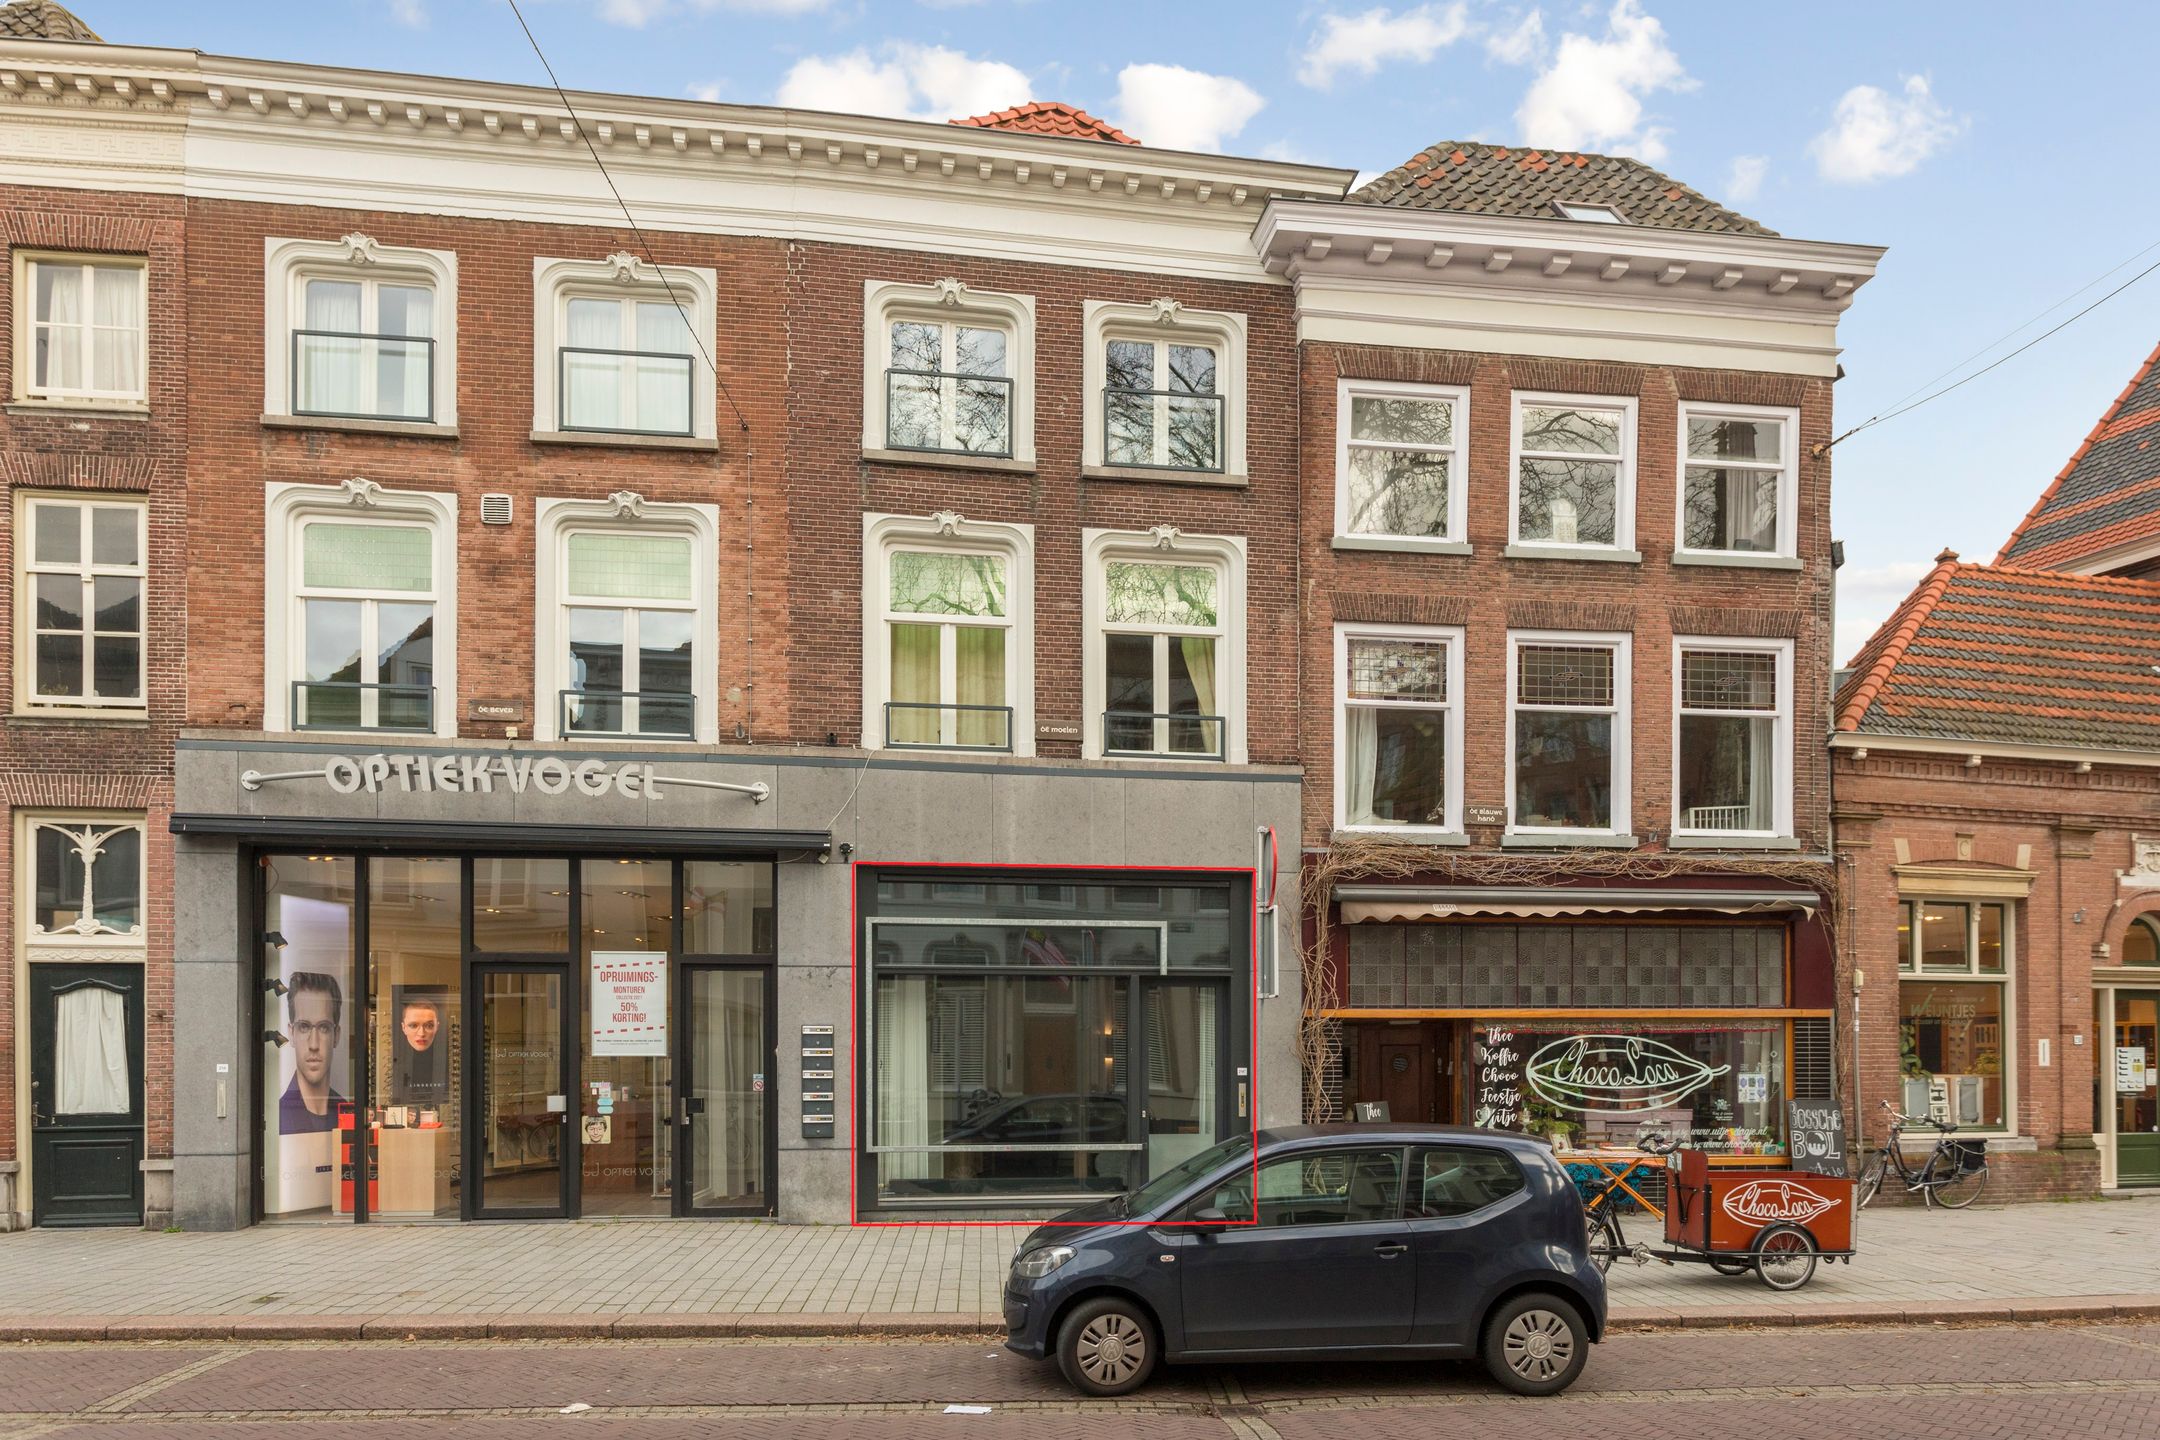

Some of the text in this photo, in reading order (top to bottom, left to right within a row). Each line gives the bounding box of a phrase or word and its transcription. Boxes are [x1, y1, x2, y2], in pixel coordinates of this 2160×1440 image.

[325, 753, 664, 800] OPTIEK VOGEL
[600, 971, 659, 983] OPRUIMINGS-
[613, 986, 646, 994] MONTUREN
[620, 1002, 639, 1012] 50%
[612, 1013, 647, 1023] KORTING!
[1480, 1047, 1520, 1067] Koffie
[1481, 1067, 1519, 1083] Choco
[603, 1167, 637, 1177] OPTIEK
